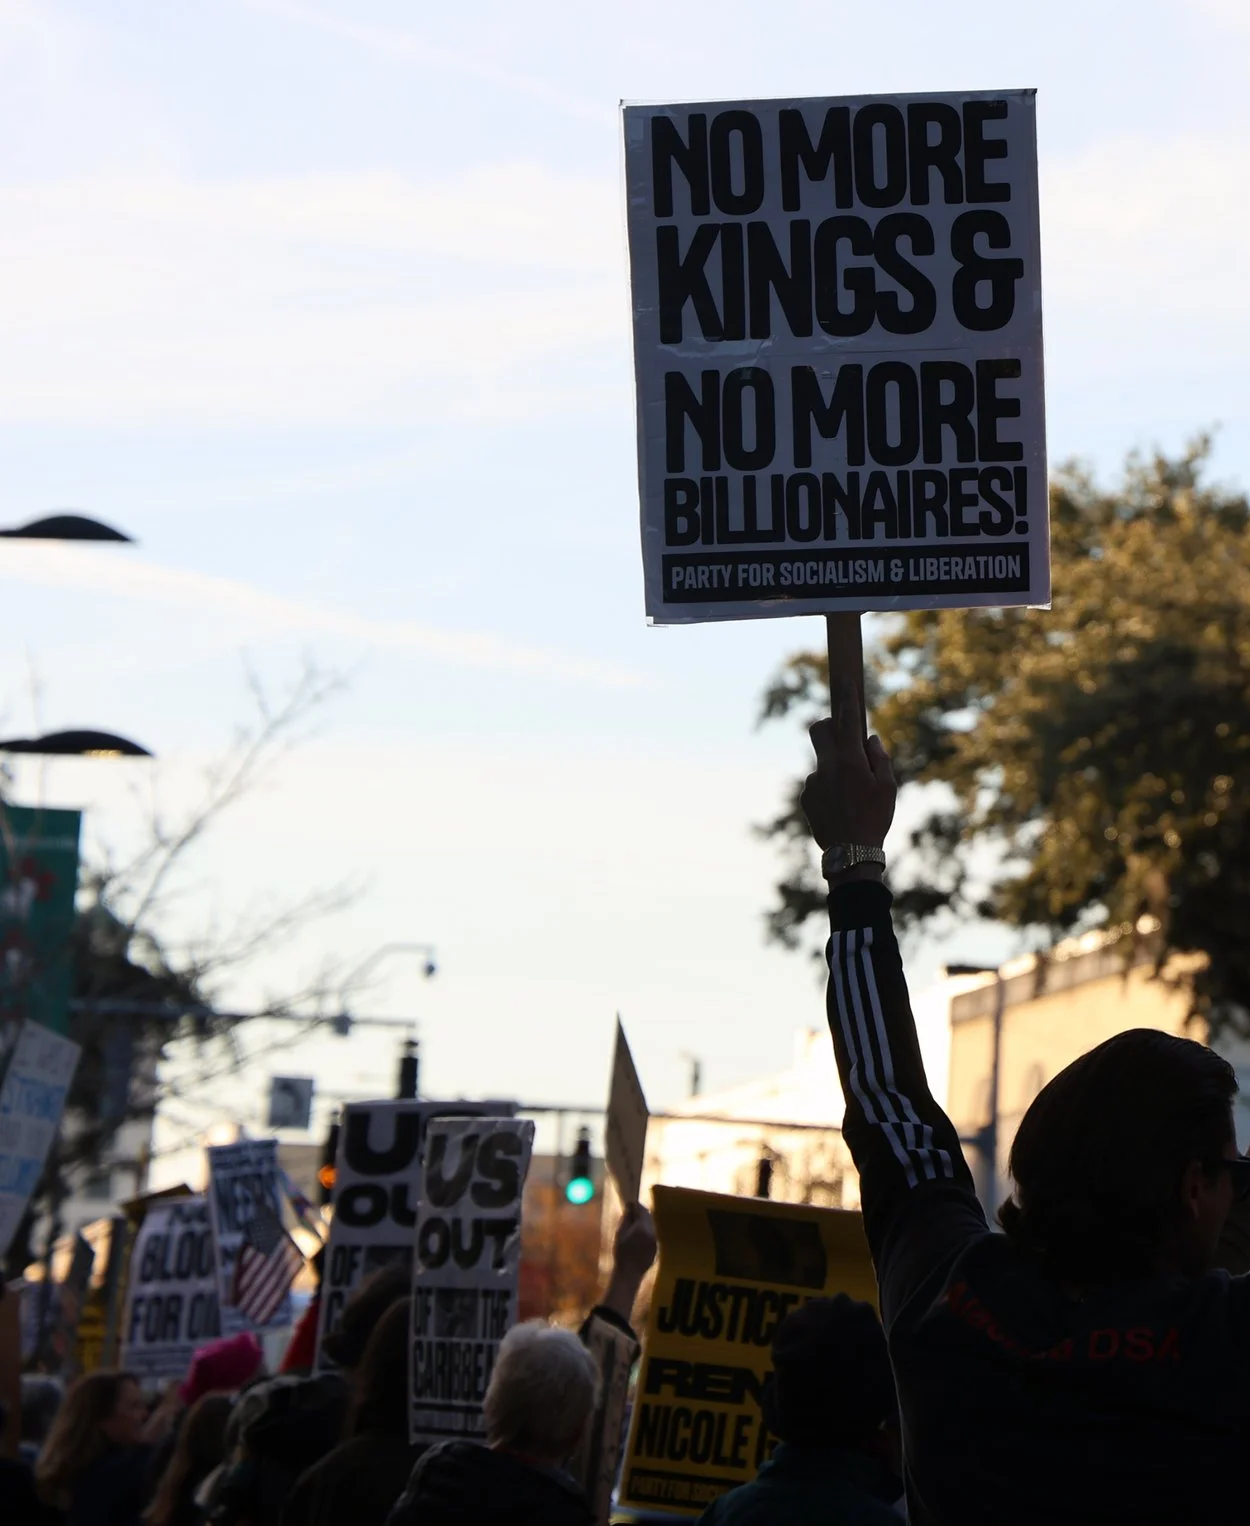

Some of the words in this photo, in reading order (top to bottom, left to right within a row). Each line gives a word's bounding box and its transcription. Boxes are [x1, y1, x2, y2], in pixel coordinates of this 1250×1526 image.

[651, 110, 765, 218] NO
[779, 100, 1011, 212] MORE
[656, 213, 937, 344] KINGS
[950, 209, 1024, 331] &
[664, 366, 775, 473] NO
[791, 358, 1023, 469] MORE
[663, 466, 1028, 547] BILLIONAIRES!
[671, 564, 733, 590] PARTY
[737, 561, 775, 587] FOR
[779, 557, 884, 586] SOCIALISM
[889, 559, 904, 580] &
[908, 554, 1020, 582] LIBERATION
[425, 1132, 523, 1209] US
[336, 1183, 416, 1228] OU
[140, 1230, 216, 1282] BLOO
[418, 1217, 517, 1271] OUT
[413, 1340, 495, 1403] CARIBBE
[1088, 1324, 1183, 1366] DSA
[644, 1357, 777, 1406] REN
[634, 1403, 753, 1469] NICOLE
